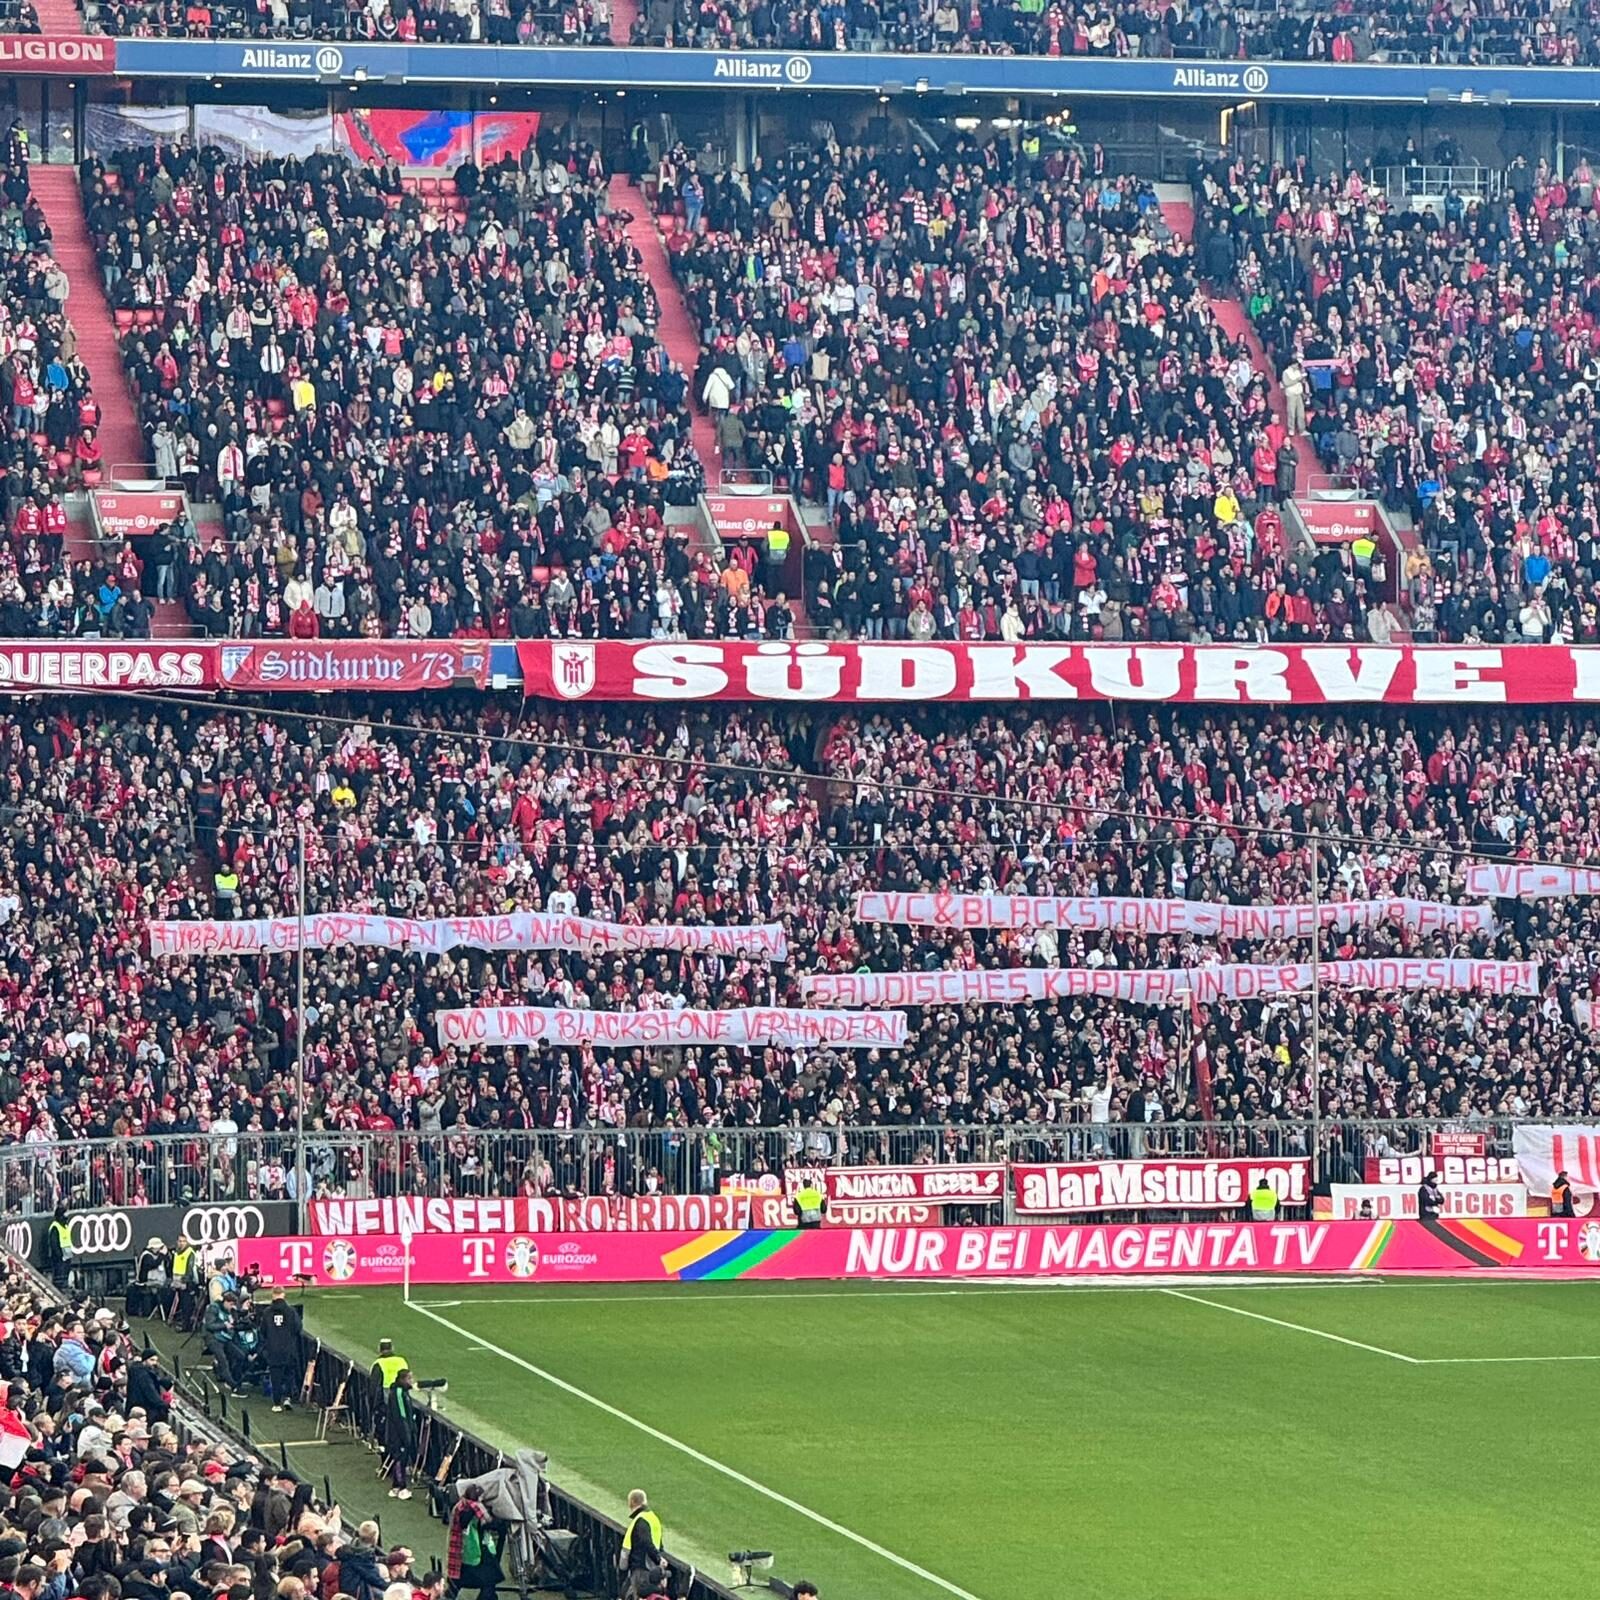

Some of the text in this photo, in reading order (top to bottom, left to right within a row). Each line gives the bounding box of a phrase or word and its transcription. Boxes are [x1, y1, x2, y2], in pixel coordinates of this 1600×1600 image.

[242, 49, 312, 68] Allianz
[714, 59, 783, 77] Allianz
[1173, 69, 1240, 87] Allianz
[711, 503, 726, 512] 222
[102, 517, 134, 526] Allianz
[1344, 526, 1369, 534] Arena
[259, 650, 404, 681] Südkurve
[632, 642, 1507, 702] SÜDKURVE
[1471, 867, 1534, 895] CVC
[859, 895, 925, 922] CVC
[384, 918, 438, 946] DEN
[813, 972, 1029, 1006] SAUDISCHES
[1235, 966, 1300, 997] DER
[443, 1010, 487, 1040] CVC
[555, 1009, 731, 1040] BLACKSTONE
[923, 1172, 999, 1195] REBELS
[1023, 1164, 1241, 1208] alarMstufe
[763, 1198, 799, 1227] RE
[542, 1254, 597, 1265] EURO2024
[845, 1225, 1330, 1273] NUR BEI MAGENTA TV
